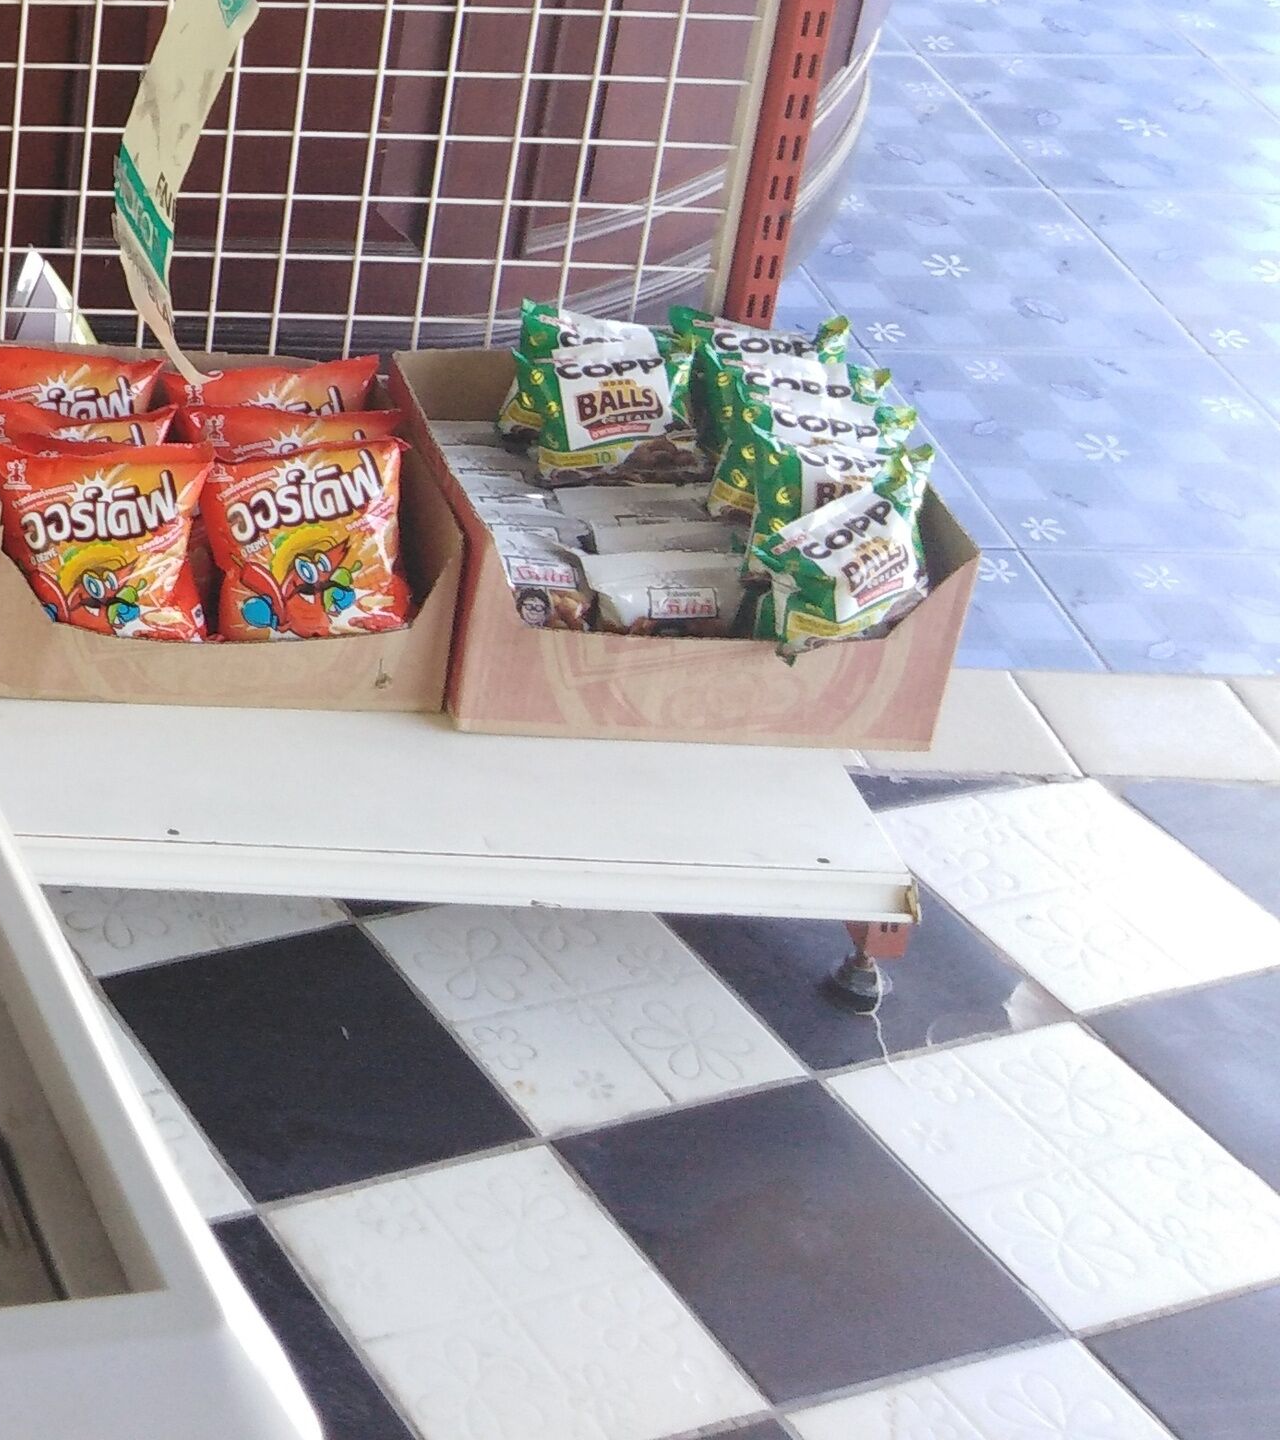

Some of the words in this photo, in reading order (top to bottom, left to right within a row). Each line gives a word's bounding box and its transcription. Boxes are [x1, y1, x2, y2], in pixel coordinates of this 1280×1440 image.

[555, 358, 665, 380] COPP
[576, 388, 656, 422] BALLS
[772, 409, 879, 441] COPP
[20, 468, 179, 553] ออร์เดิฟ
[226, 448, 383, 544] ออร์เดิฟ
[802, 501, 893, 560] COPP
